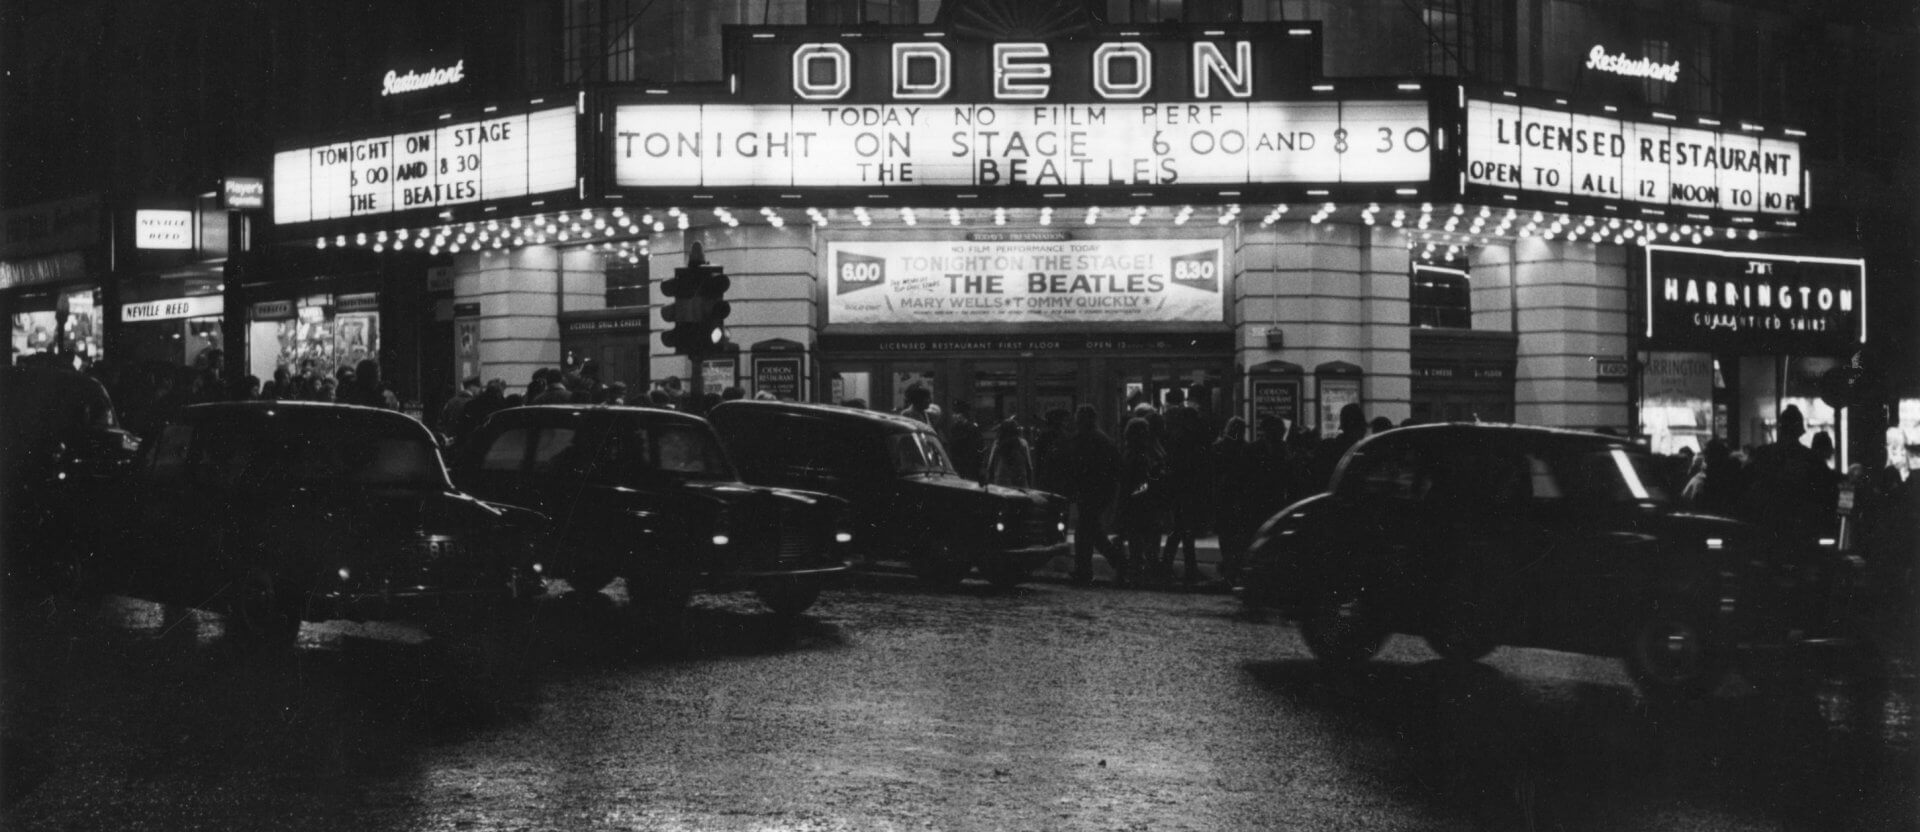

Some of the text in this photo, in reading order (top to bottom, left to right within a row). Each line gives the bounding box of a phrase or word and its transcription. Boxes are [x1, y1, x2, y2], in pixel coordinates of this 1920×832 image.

[792, 40, 1252, 99] ODEON
[1586, 44, 1680, 83] Restaurant
[381, 59, 465, 96] Restaurant
[821, 104, 1222, 127] TODAY NO FILM PERF
[317, 122, 511, 166] TONIGHT ON STAGE
[618, 127, 1430, 158] TONIGHT ON STAGE 6 00 AND 8 30
[1497, 118, 1791, 176] LICENSED RESTAURANT
[366, 166, 388, 183] 00
[396, 160, 428, 181] AND
[440, 157, 448, 174] 8
[456, 154, 479, 172] 30
[857, 158, 1179, 185] THE BEATLES
[226, 181, 263, 197] Player's
[1469, 160, 1521, 183] OPEN
[1534, 167, 1560, 187] TO
[1581, 173, 1619, 194] ALL
[1639, 179, 1656, 197] 12
[1671, 183, 1719, 204] NOON
[1730, 188, 1753, 207] TO
[1765, 192, 1782, 209] 10
[350, 180, 476, 212] THE BEATLES
[141, 219, 187, 227] NEVILLE
[996, 245, 1065, 253] PERFORMANCE
[1070, 244, 1099, 253] TODAY
[841, 262, 880, 281] 6.00
[900, 254, 1154, 272] TONIGHT ON THE STAGE!
[1175, 260, 1214, 279] 8.30
[944, 272, 1164, 294] THE BEATLES
[900, 297, 945, 308] MARY
[950, 296, 1001, 308] WELLS
[1076, 295, 1139, 308] QUICKLY
[1664, 278, 1852, 311] HARRINGTON
[126, 302, 189, 319] NEVILLE REED
[879, 342, 926, 350] LICENSED
[932, 341, 992, 350] RESTAURANT
[999, 341, 1021, 349] FIRST
[1029, 341, 1060, 349] FLOOR
[1086, 341, 1112, 349] OPEN
[762, 366, 791, 374] ODEON
[1645, 359, 1709, 376] ARRINGTON
